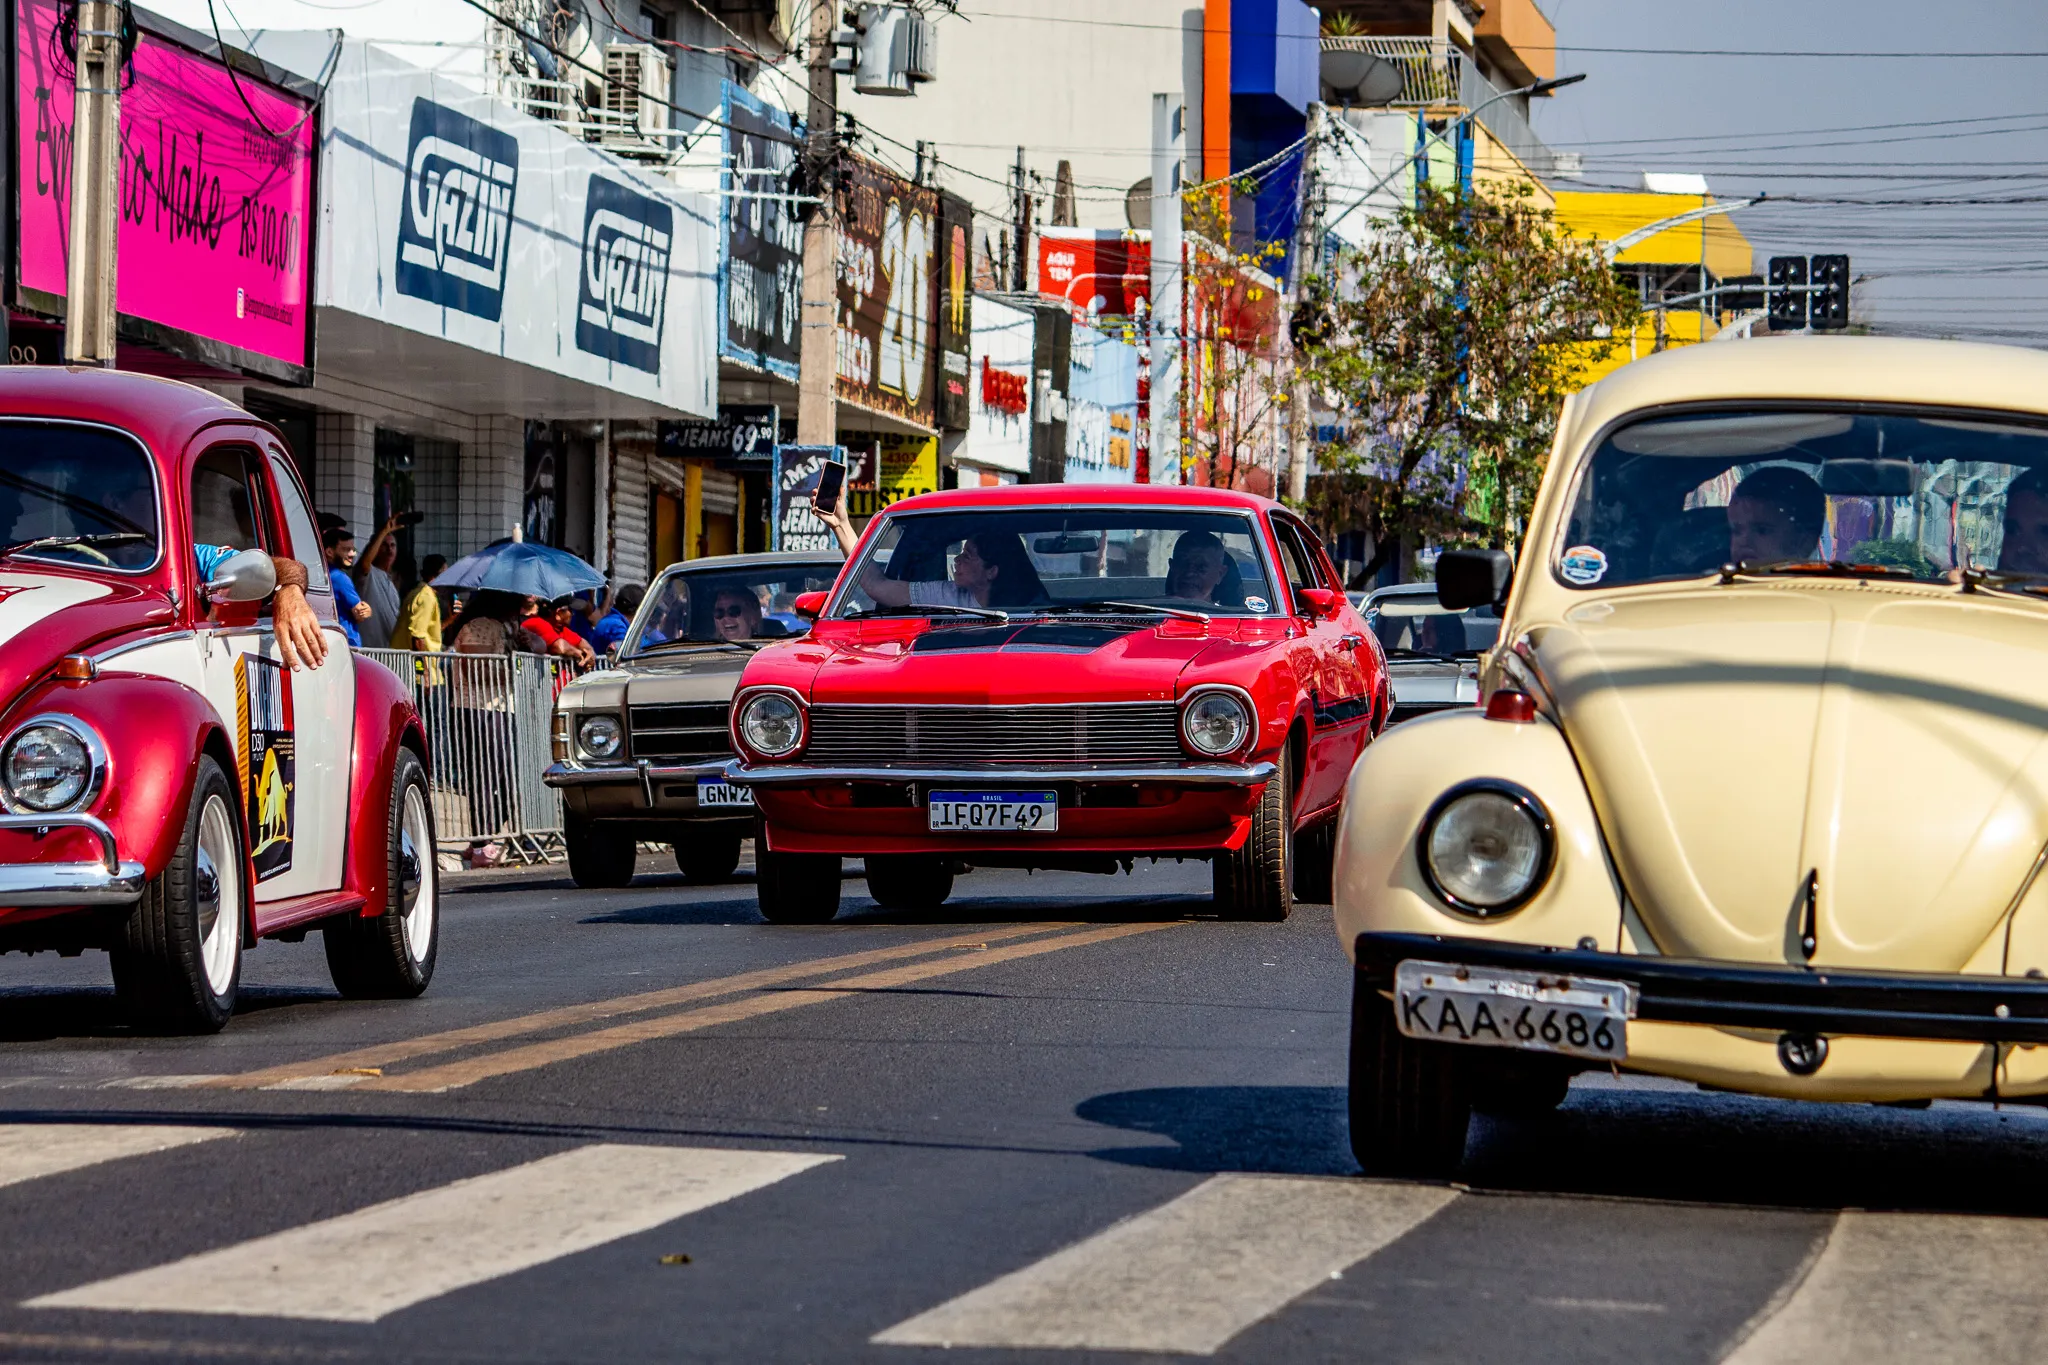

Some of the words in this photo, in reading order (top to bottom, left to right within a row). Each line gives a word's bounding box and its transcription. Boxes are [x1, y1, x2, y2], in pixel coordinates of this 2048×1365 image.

[156, 117, 227, 251] Make
[1046, 252, 1075, 267] AQUI
[1048, 267, 1072, 282] TEM
[678, 427, 731, 448] JEANS
[706, 785, 757, 804] GNW2
[940, 803, 1043, 827] IFQ7F49
